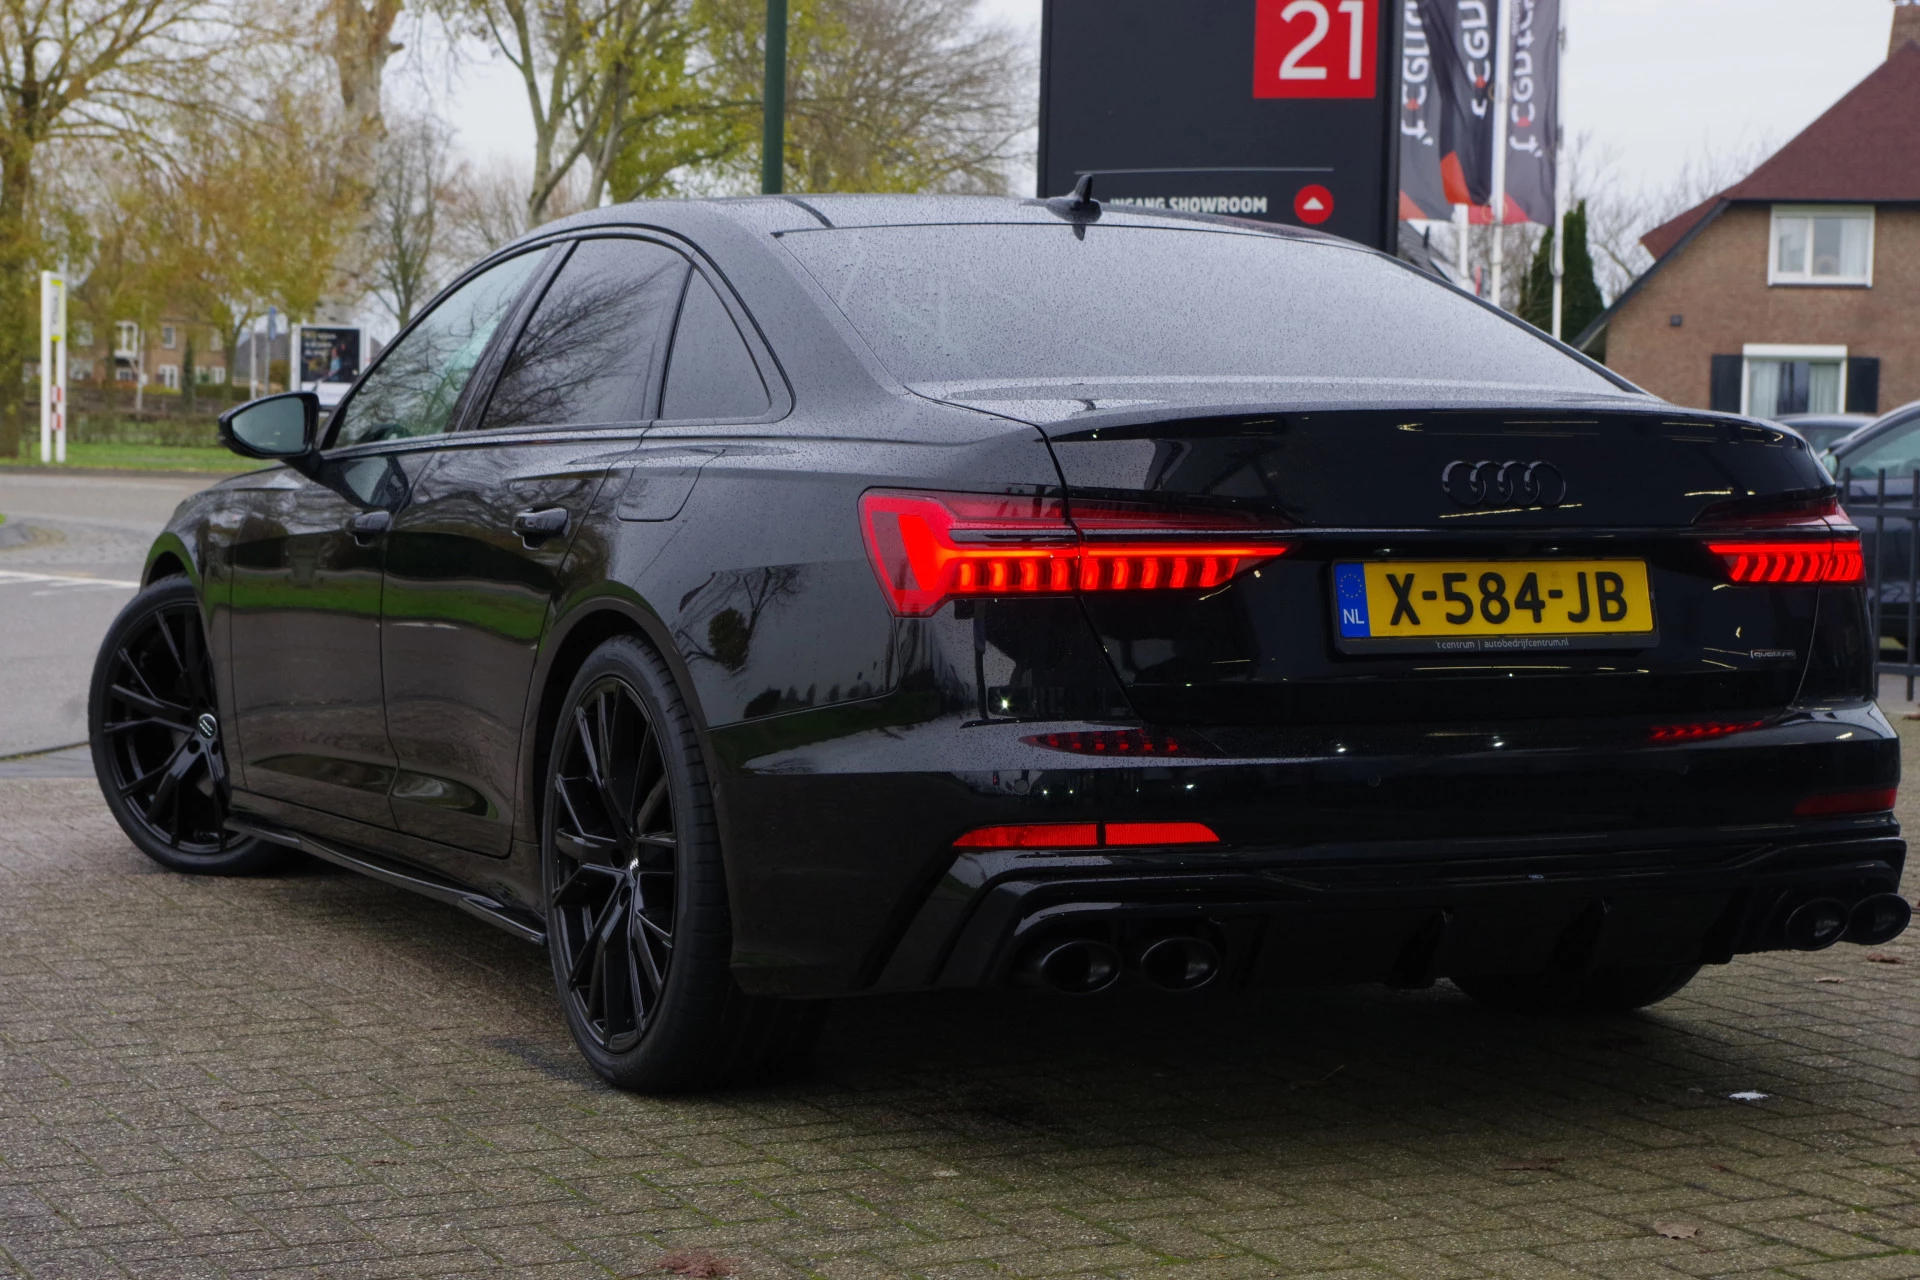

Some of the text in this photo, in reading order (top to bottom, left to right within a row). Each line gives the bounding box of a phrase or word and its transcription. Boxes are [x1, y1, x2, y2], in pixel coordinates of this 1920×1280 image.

[1279, 0, 1364, 80] 21
[1168, 196, 1268, 213] SHOWROOM
[1385, 571, 1628, 626] X-584-JB
[1343, 608, 1365, 625] NL
[1442, 640, 1475, 649] centrum
